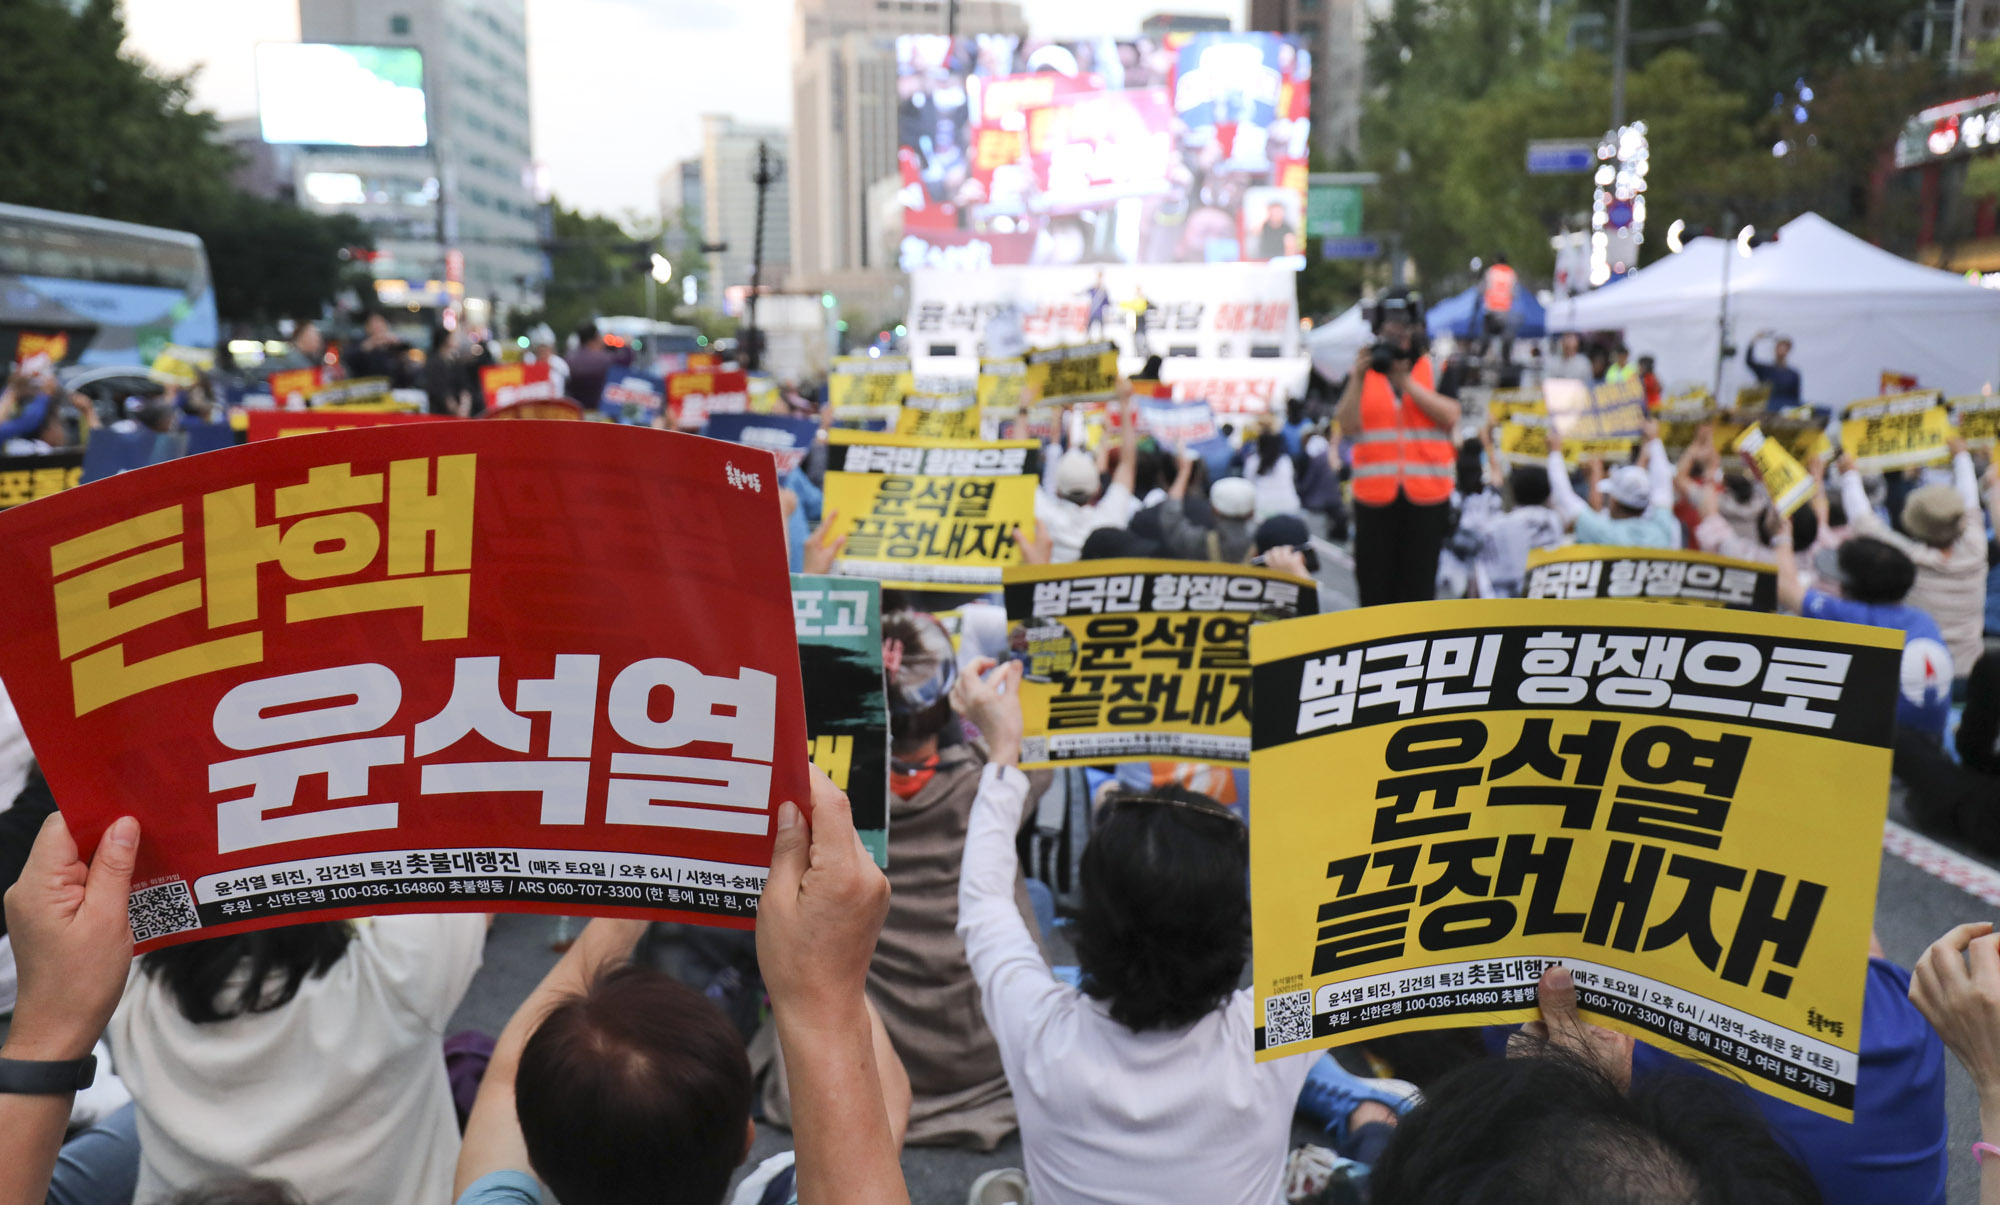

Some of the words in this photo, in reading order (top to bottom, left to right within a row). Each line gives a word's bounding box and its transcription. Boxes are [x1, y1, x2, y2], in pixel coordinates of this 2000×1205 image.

[873, 478, 995, 518] 윤석열
[50, 453, 477, 717] 탄핵
[1033, 575, 1145, 617] 범국민
[1296, 634, 1503, 735] 범국민
[1516, 631, 1853, 730] 항쟁으로
[208, 654, 777, 854] 윤석열
[1371, 718, 1752, 850] 윤석열
[214, 874, 267, 896] 윤석열
[272, 870, 313, 888] 퇴진,
[316, 865, 367, 885] 김건희
[370, 859, 401, 876] 특검
[406, 851, 521, 875] 촛불대행진
[528, 859, 561, 876] (매주
[565, 861, 606, 877] 토요일
[620, 864, 647, 879] 오후
[651, 866, 673, 882] 6시
[220, 900, 252, 917] 후원
[266, 889, 326, 910] 신한은행
[330, 881, 445, 901] 100-036-164860
[448, 879, 504, 895] 촛불행동
[518, 882, 545, 895] ARS
[548, 883, 641, 900] 060-707-3300
[645, 886, 664, 902] (한
[667, 887, 695, 905] 통에
[698, 891, 720, 908] 1만
[1310, 834, 1828, 1000] 끝장내자!
[1328, 987, 1364, 1008] 윤석열
[1367, 981, 1395, 1001] 퇴진,
[1399, 976, 1436, 994] 김건희
[1439, 972, 1464, 988] 특검
[1570, 969, 1599, 987] (매주
[1603, 978, 1640, 999] 토요일
[1651, 991, 1675, 1010] 오후
[1677, 1002, 1697, 1020] 6시
[1789, 1044, 1803, 1060] 앞
[1807, 1051, 1841, 1076] 대로)
[1328, 1012, 1350, 1028] 후원
[1359, 1003, 1403, 1022] 신한은행
[1405, 992, 1499, 1012] 100-036-164860
[1501, 986, 1538, 1005] 촛불행
[1584, 991, 1666, 1029] 060-707-3300
[1668, 1018, 1685, 1037] (한
[1687, 1023, 1711, 1046] 통에
[1713, 1037, 1735, 1056] 1만
[1755, 1052, 1781, 1076] 여러
[1784, 1066, 1799, 1083] 번
[1801, 1072, 1836, 1097] 가능)
